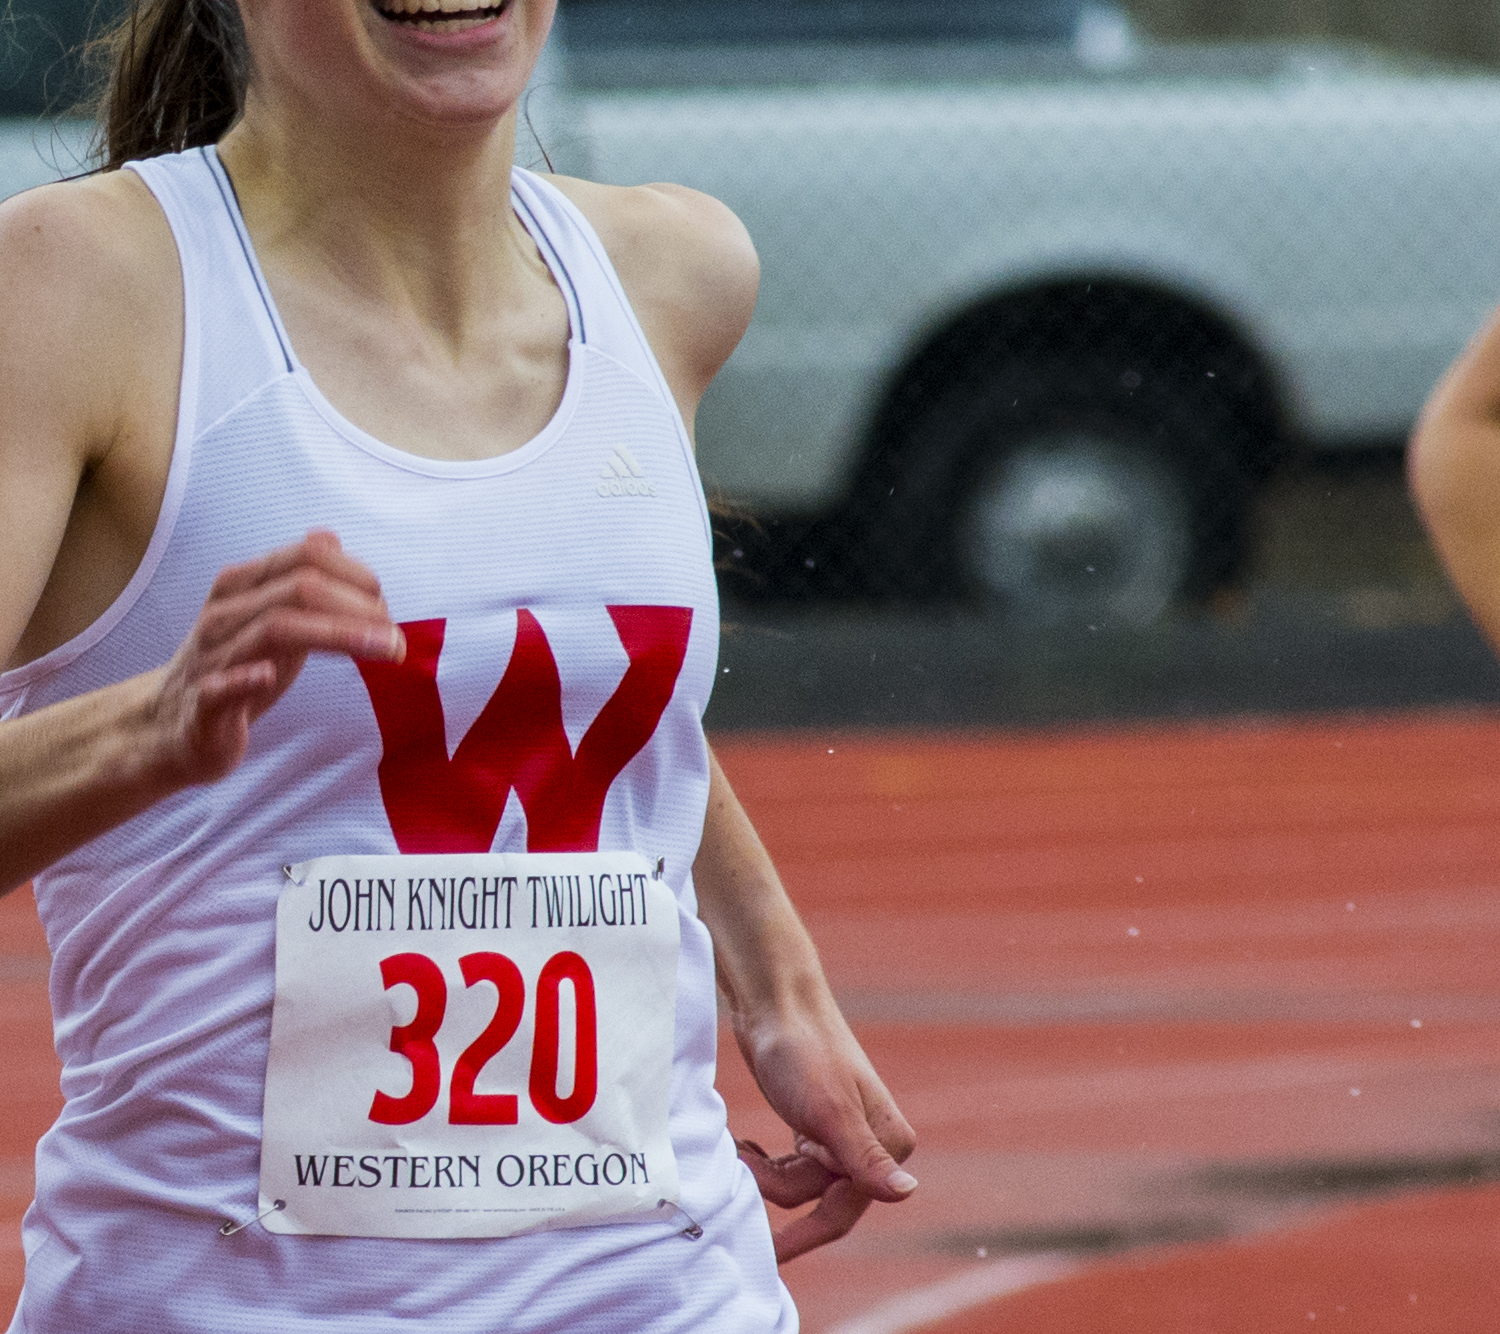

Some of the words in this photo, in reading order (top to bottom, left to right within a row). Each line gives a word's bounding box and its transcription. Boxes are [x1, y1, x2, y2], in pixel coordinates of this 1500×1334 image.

[596, 480, 658, 498] adidas
[356, 605, 694, 854] W
[308, 878, 396, 933] JOHN
[406, 875, 518, 931] KNIGHT
[525, 873, 648, 928] TWILIGHT
[367, 950, 598, 1126] 320
[294, 1154, 482, 1188] WESTERN
[495, 1152, 651, 1187] OREGON
